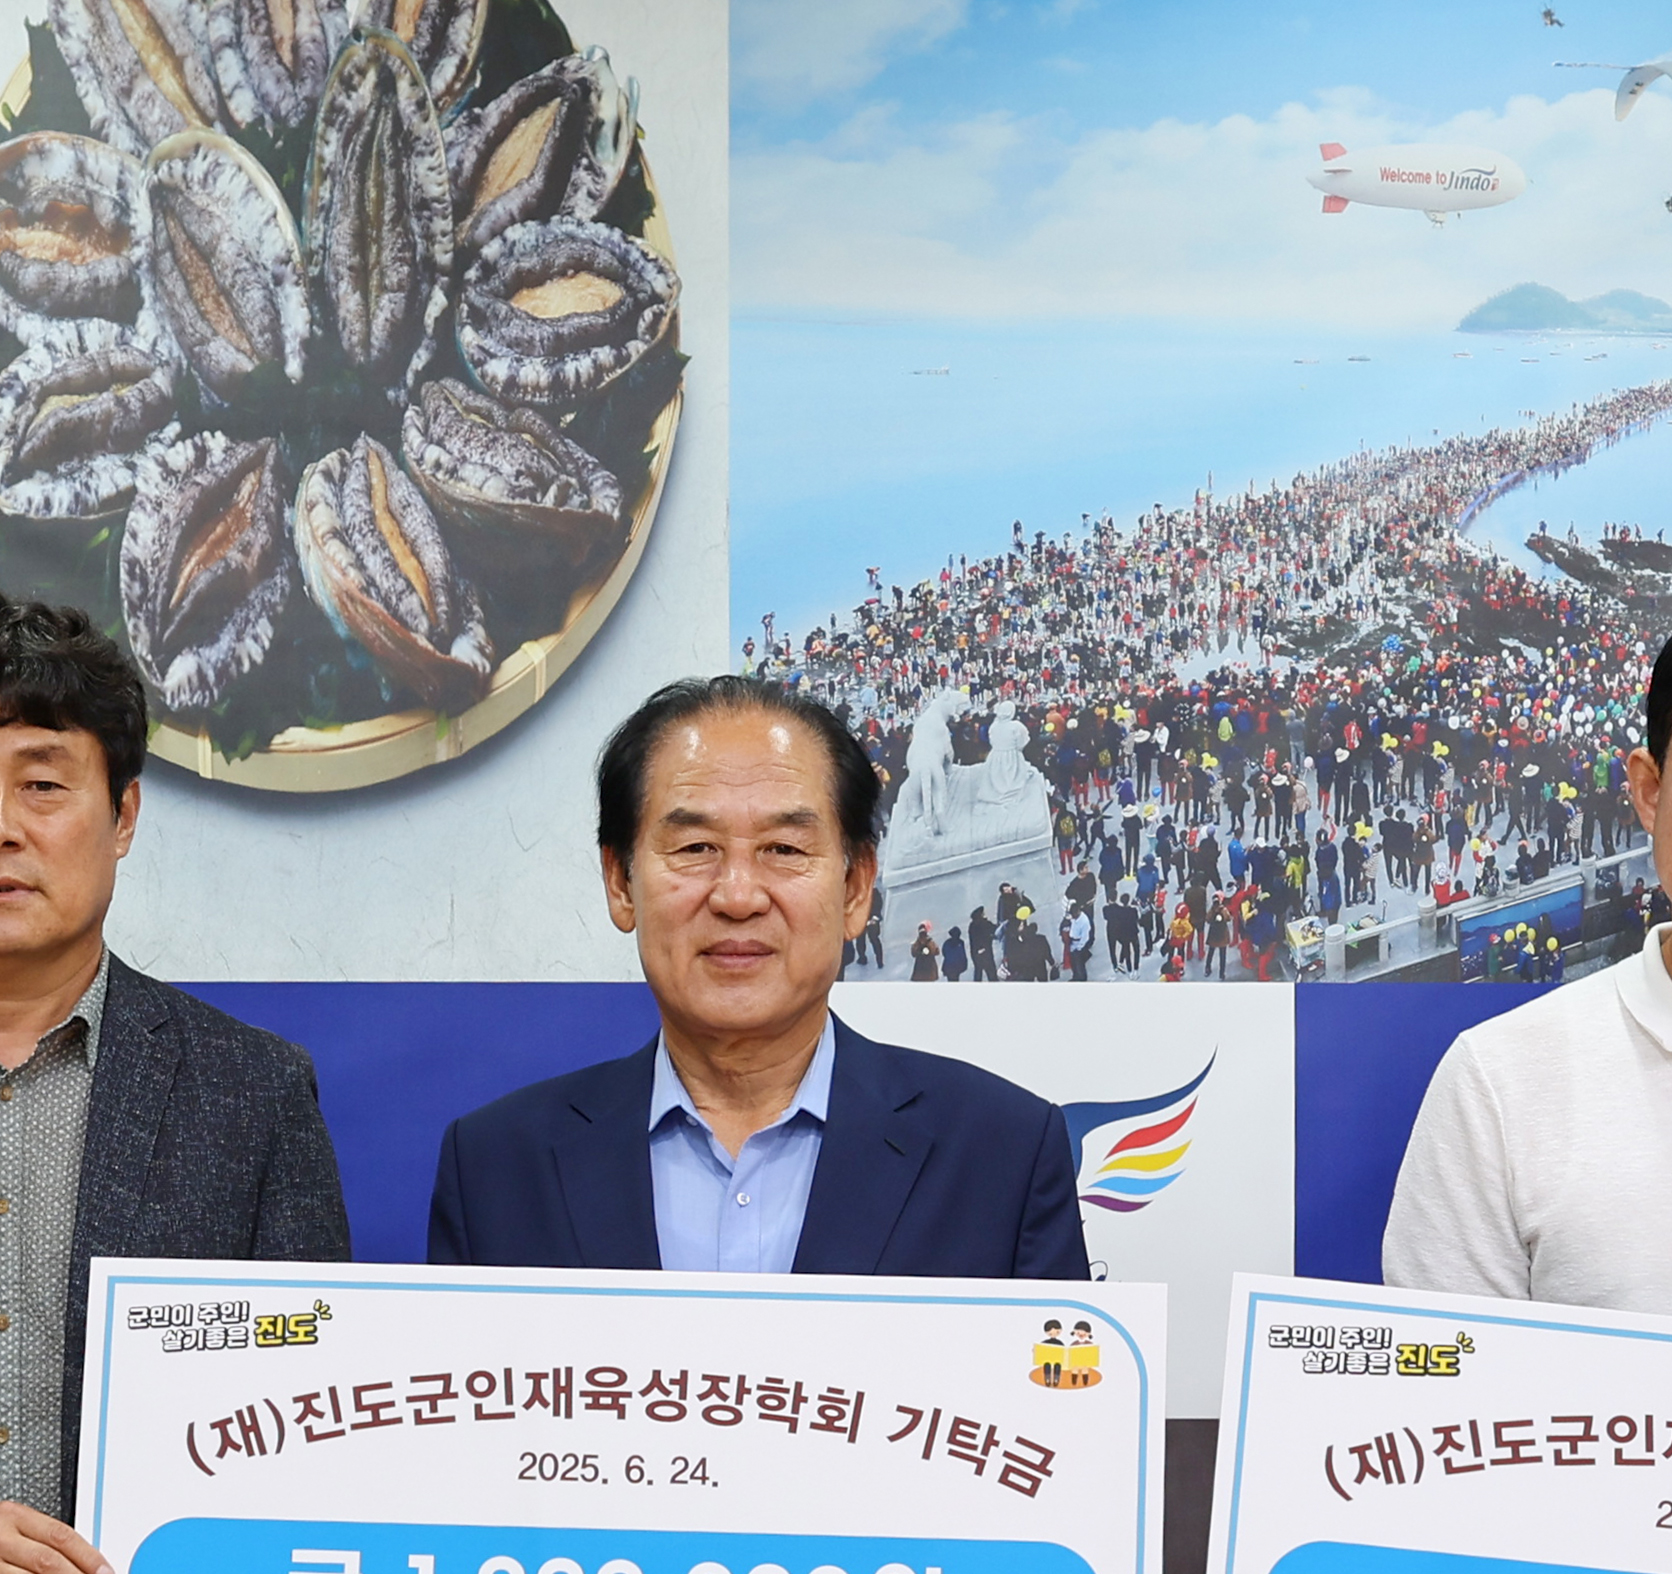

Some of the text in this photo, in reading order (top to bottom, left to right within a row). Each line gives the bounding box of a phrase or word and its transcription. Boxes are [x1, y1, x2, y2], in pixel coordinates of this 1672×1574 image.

[1379, 166, 1492, 191] Welcome to Jindo
[128, 1301, 250, 1329] 군민이 주인!
[162, 1313, 320, 1352] 살기좋은 진도
[1267, 1325, 1393, 1351] 군민이 주인!
[1302, 1343, 1462, 1376] 살기좋은 진도
[187, 1366, 1056, 1498] (재)진도군인재육성장학회 기탁금
[519, 1451, 719, 1488] 2025. 6. 24.
